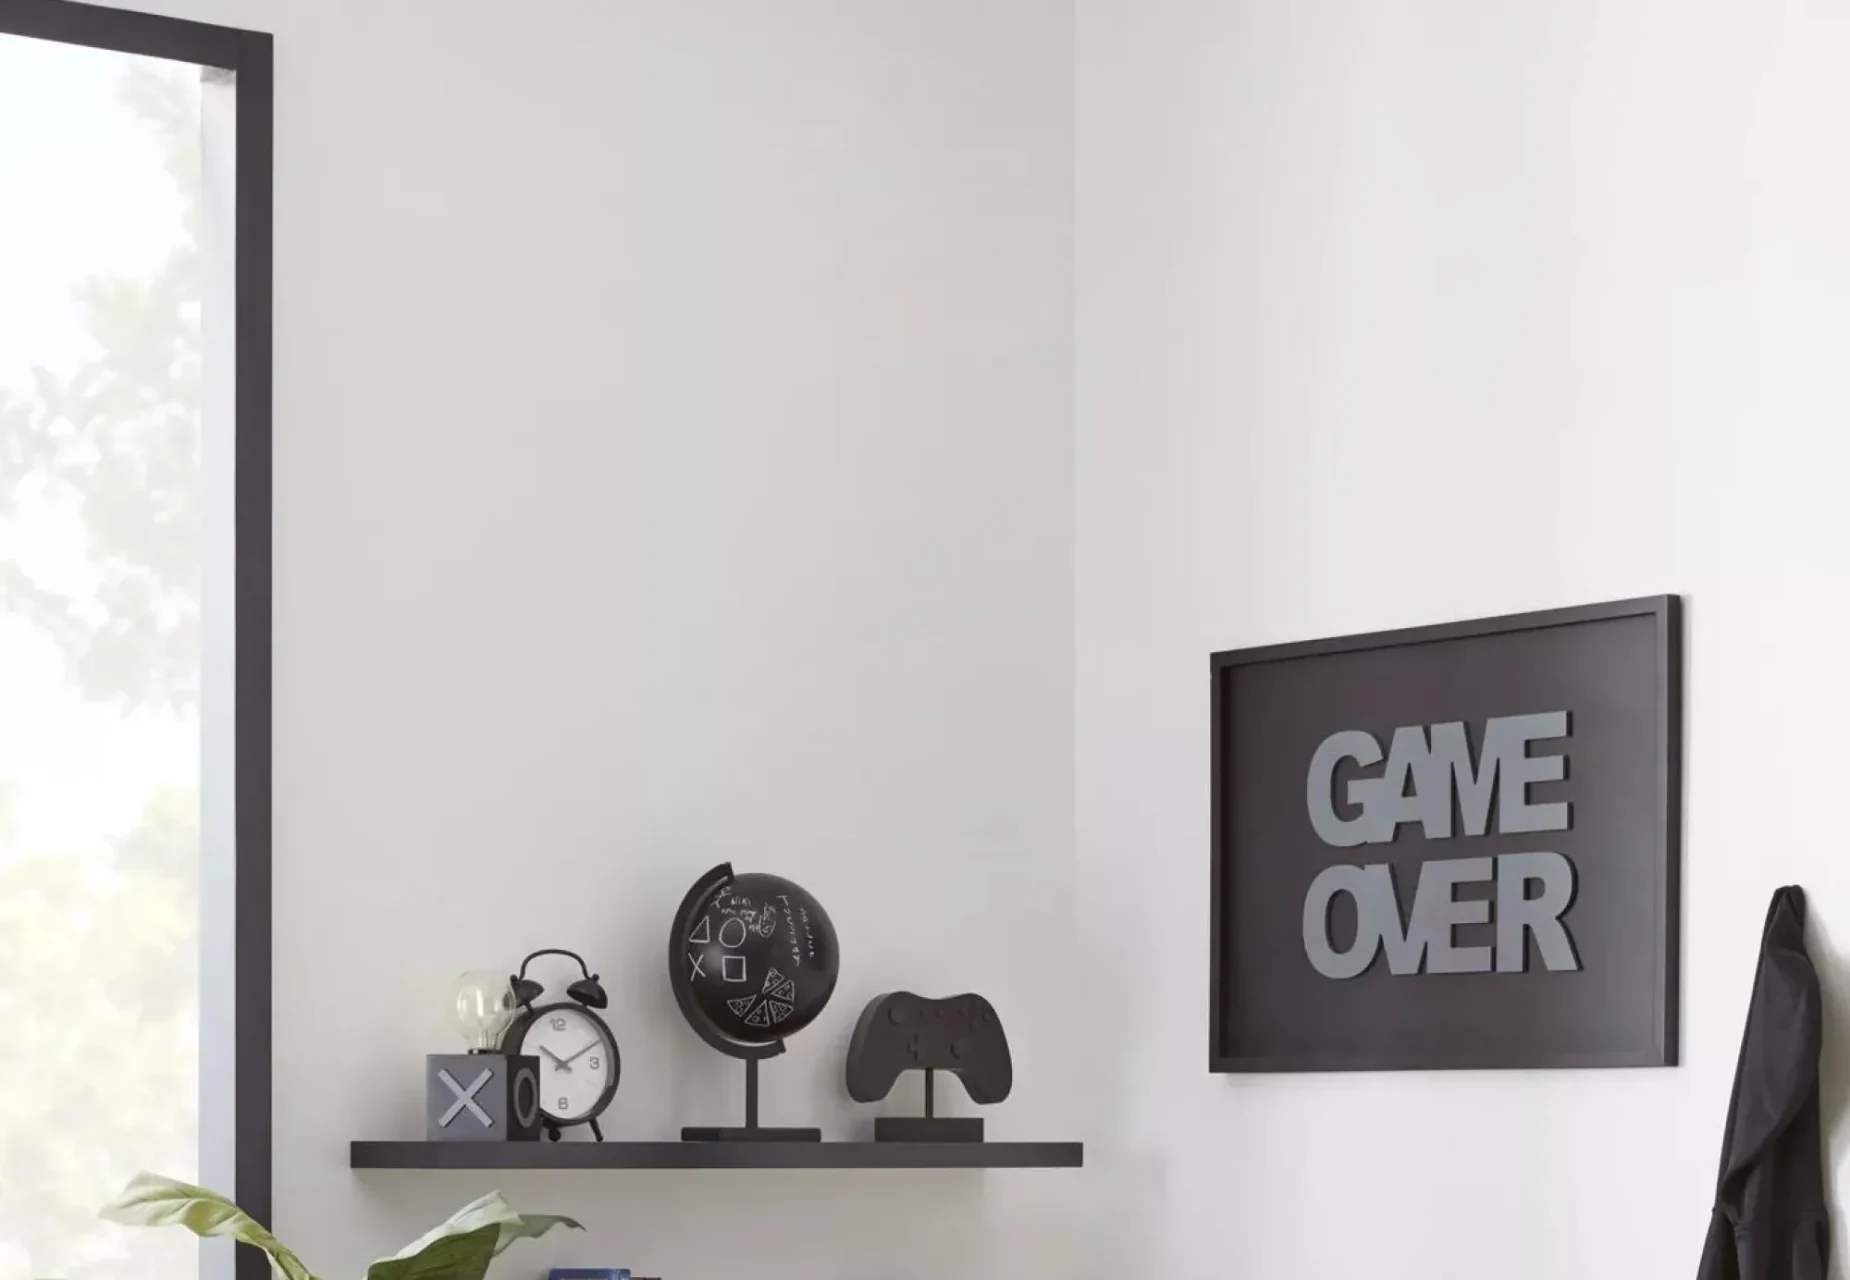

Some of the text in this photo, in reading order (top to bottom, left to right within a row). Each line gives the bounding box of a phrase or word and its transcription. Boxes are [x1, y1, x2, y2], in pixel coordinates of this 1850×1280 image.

[1307, 710, 1571, 847] GAME
[1303, 851, 1583, 980] OVER
[549, 1018, 567, 1031] 12
[589, 1056, 600, 1070] 3
